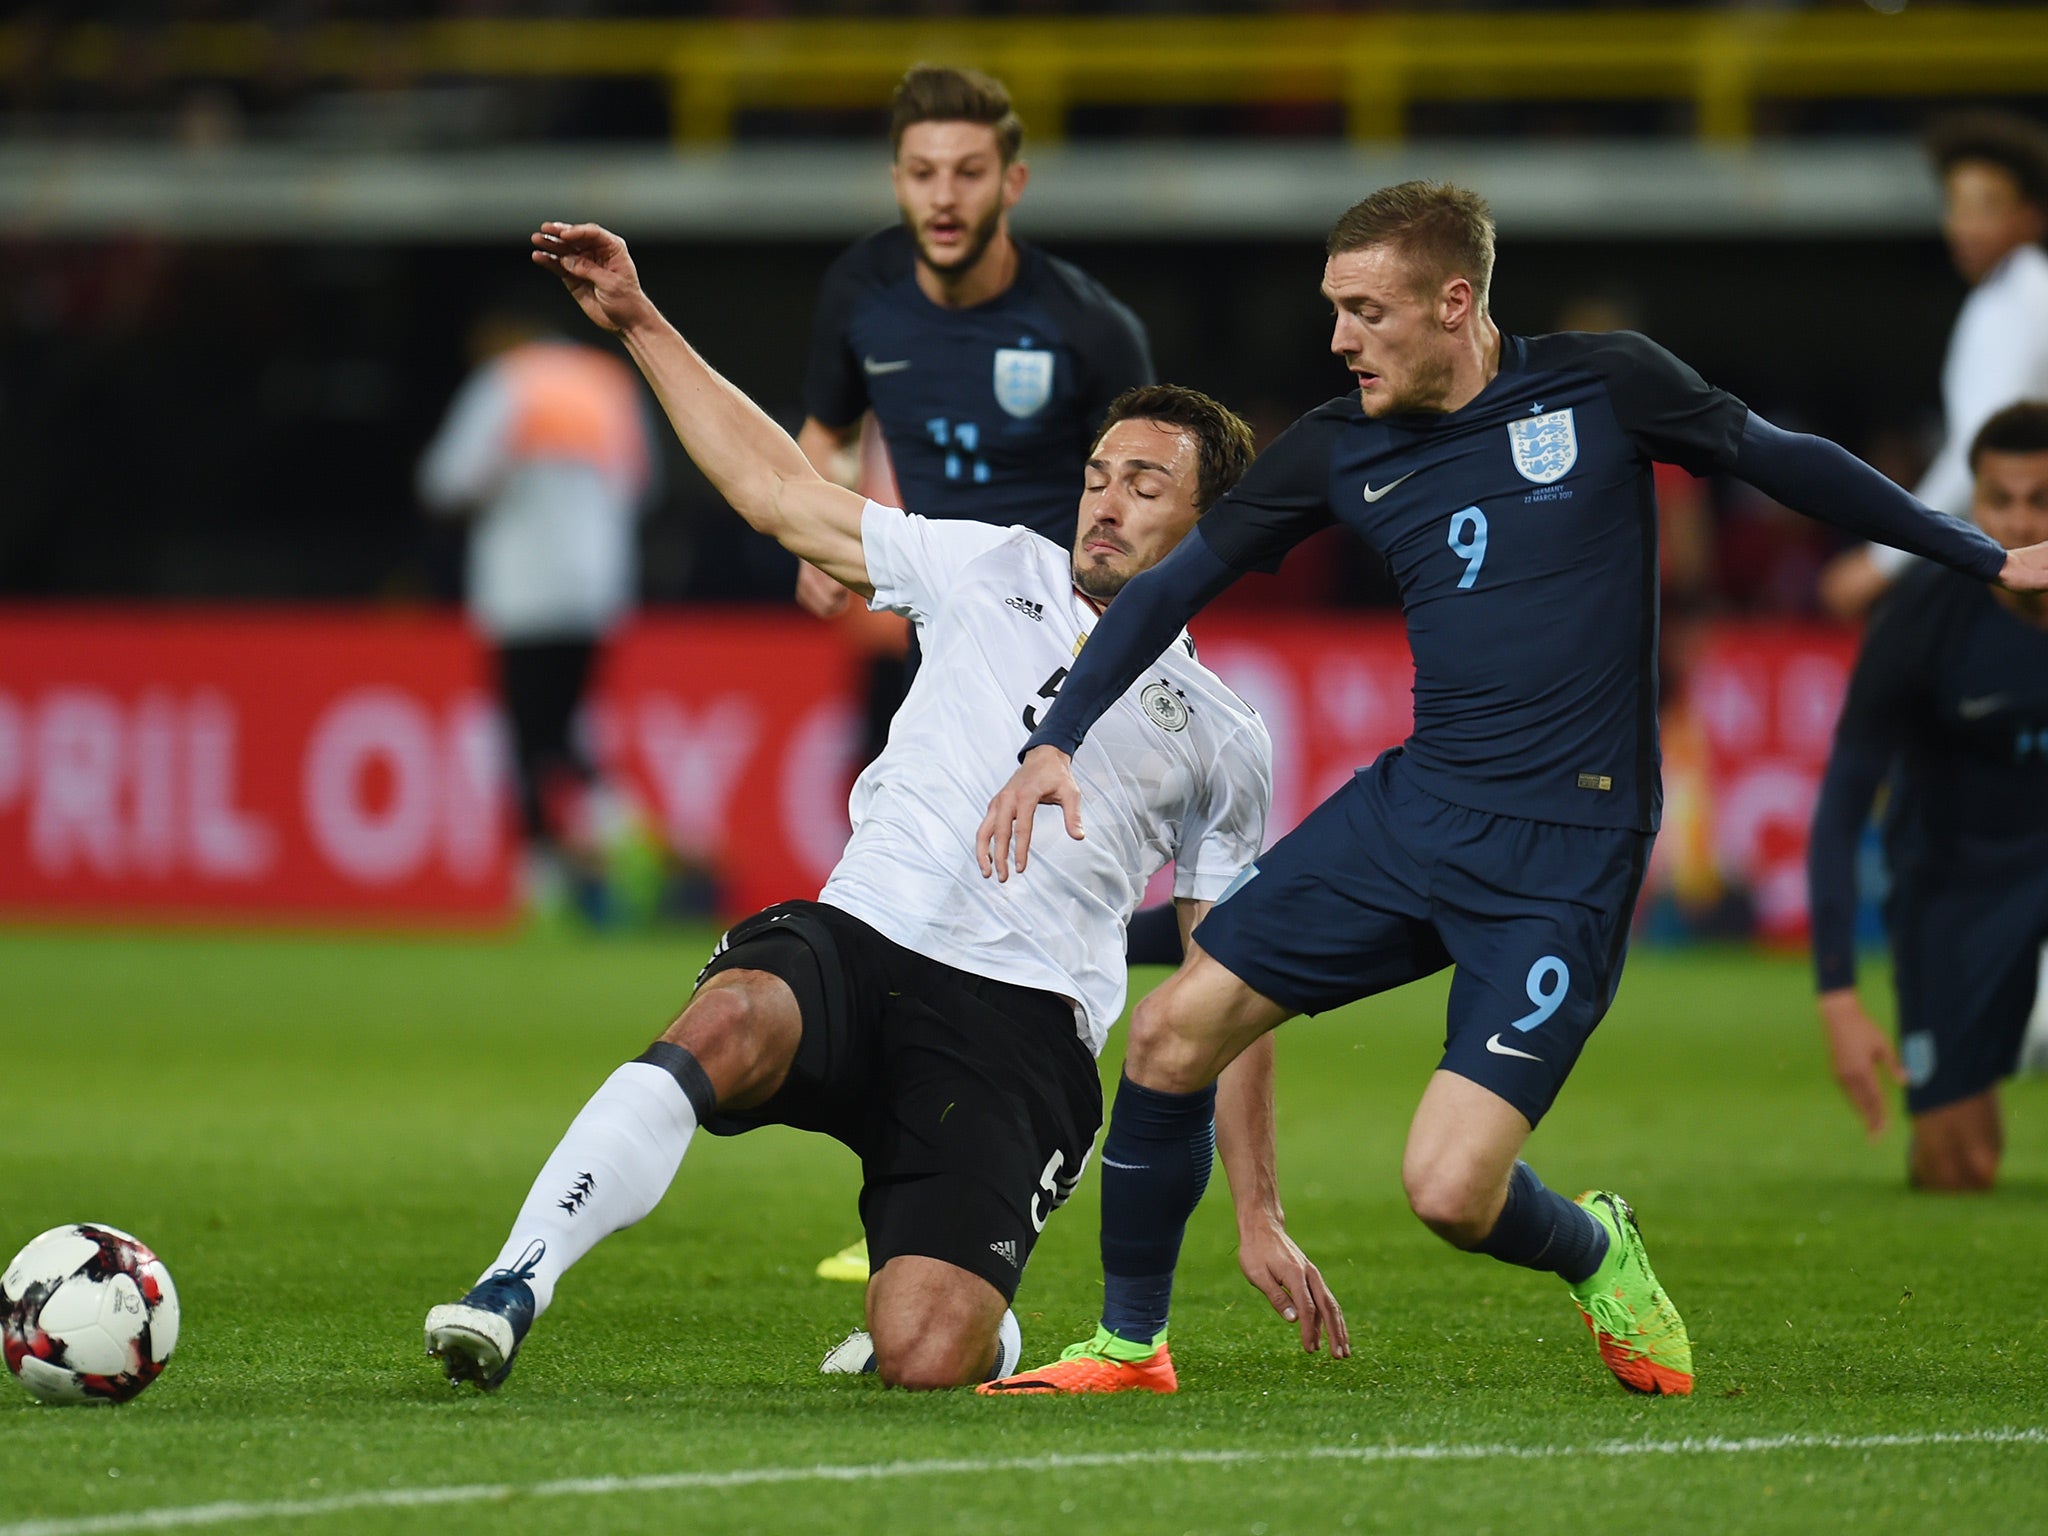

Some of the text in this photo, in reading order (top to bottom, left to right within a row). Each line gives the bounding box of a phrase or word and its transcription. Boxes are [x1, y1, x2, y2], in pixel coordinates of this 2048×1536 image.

[926, 417, 991, 484] 11
[1532, 485, 1564, 496] GERMANY
[1533, 493, 1557, 502] MARCH
[1559, 490, 1573, 500] 2017
[1447, 506, 1488, 588] 9
[1005, 598, 1043, 622] adidas
[0, 684, 281, 876] RIL
[1511, 955, 1570, 1033] 9
[1031, 1149, 1064, 1233] 5
[990, 1243, 1018, 1268] adidas
